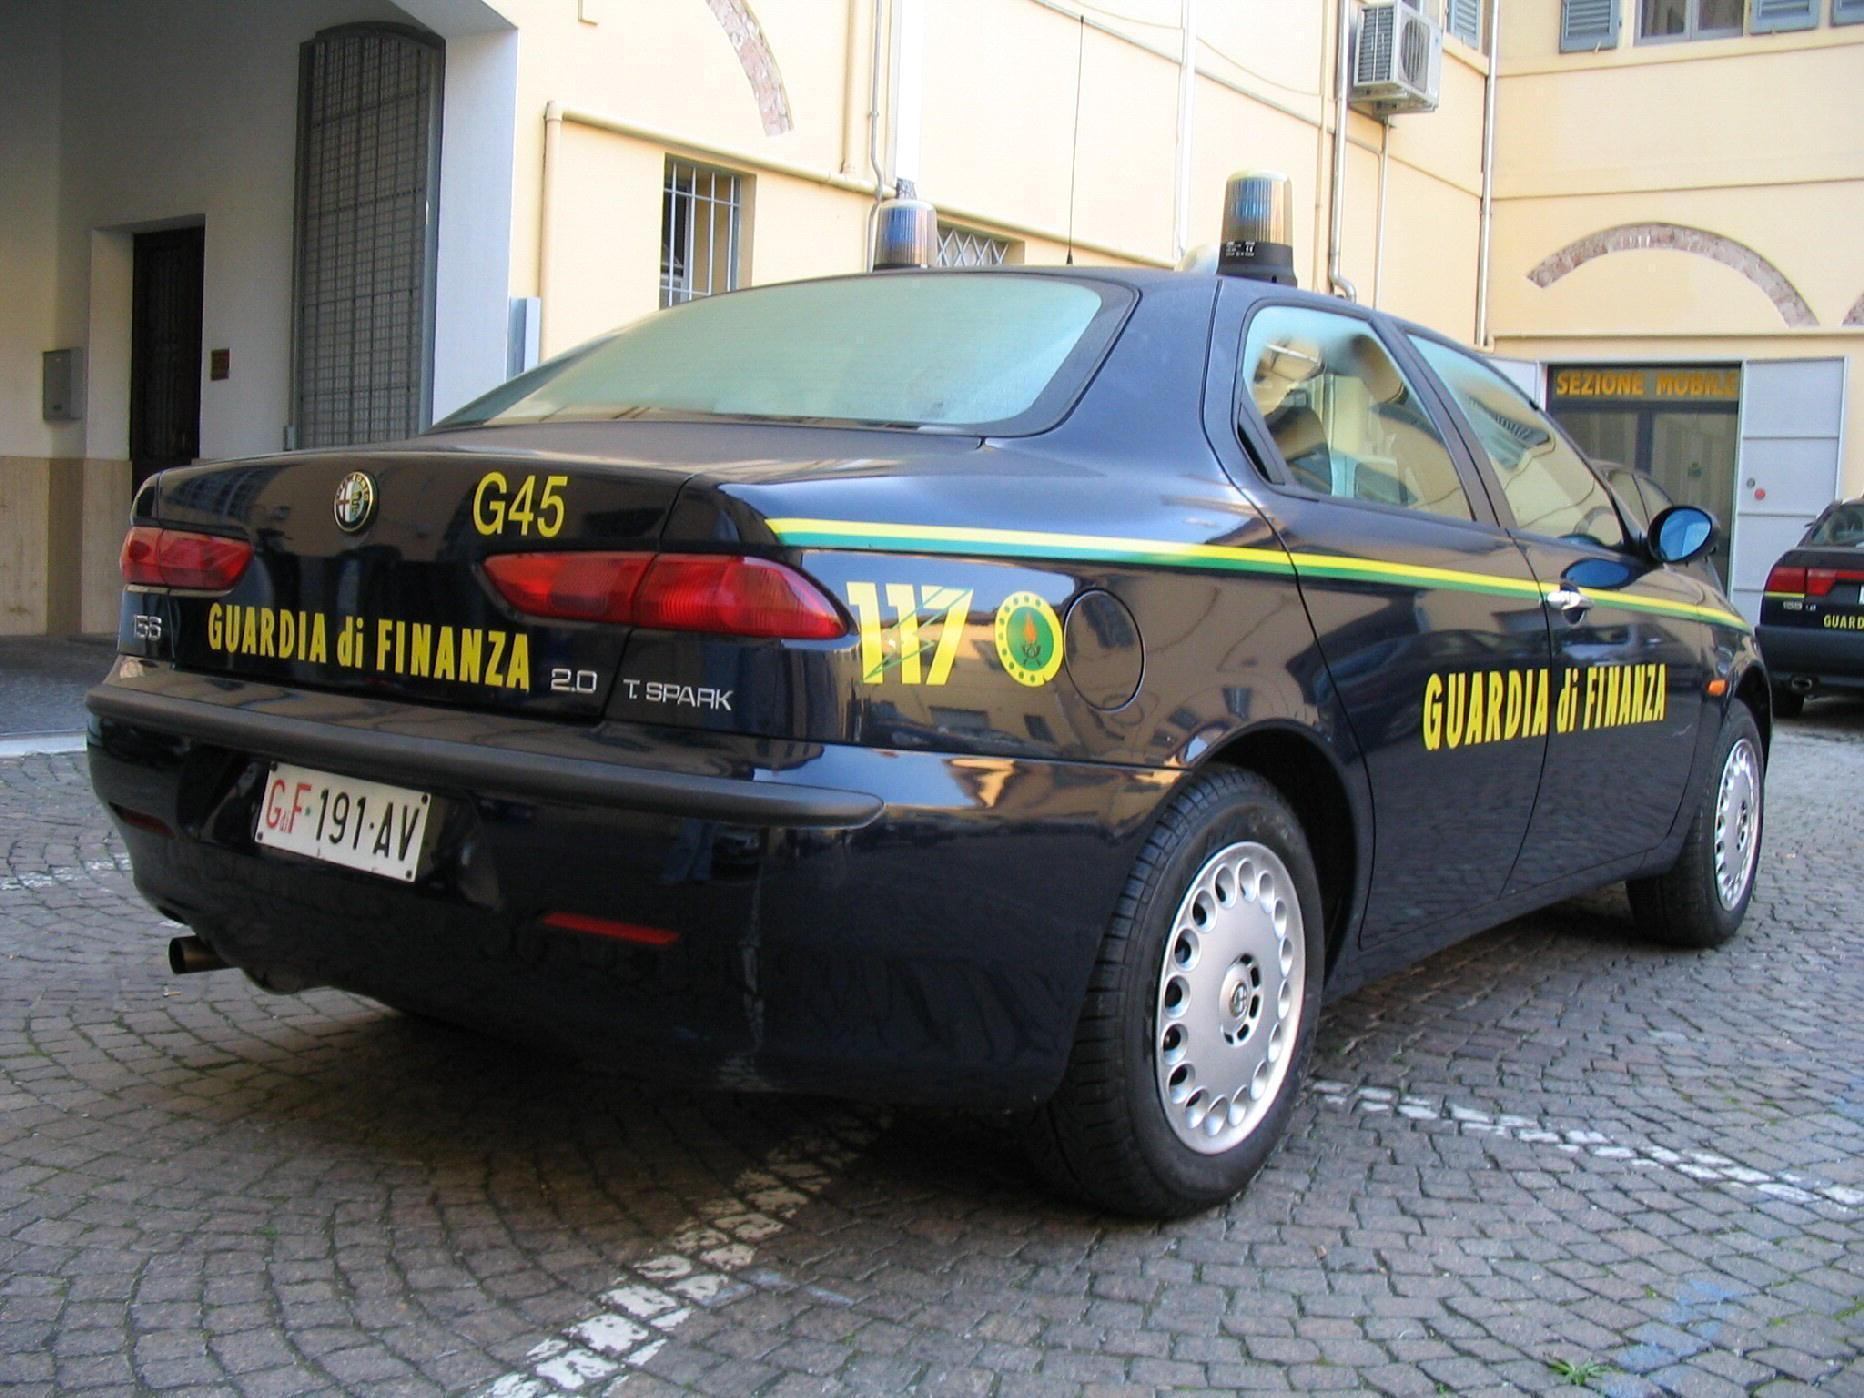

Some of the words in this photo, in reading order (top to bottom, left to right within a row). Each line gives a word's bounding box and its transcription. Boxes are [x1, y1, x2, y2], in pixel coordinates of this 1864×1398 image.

[1556, 371, 1645, 397] SEZIONE
[473, 471, 568, 538] G45
[207, 602, 327, 664] GUARDIA
[336, 614, 363, 669] di
[376, 618, 530, 691] FINANZA
[846, 581, 974, 686] 117
[645, 682, 734, 711] SPARK
[1423, 668, 1548, 751] GUARDIA
[1556, 668, 1579, 733] di
[1583, 663, 1666, 730] FINANZA
